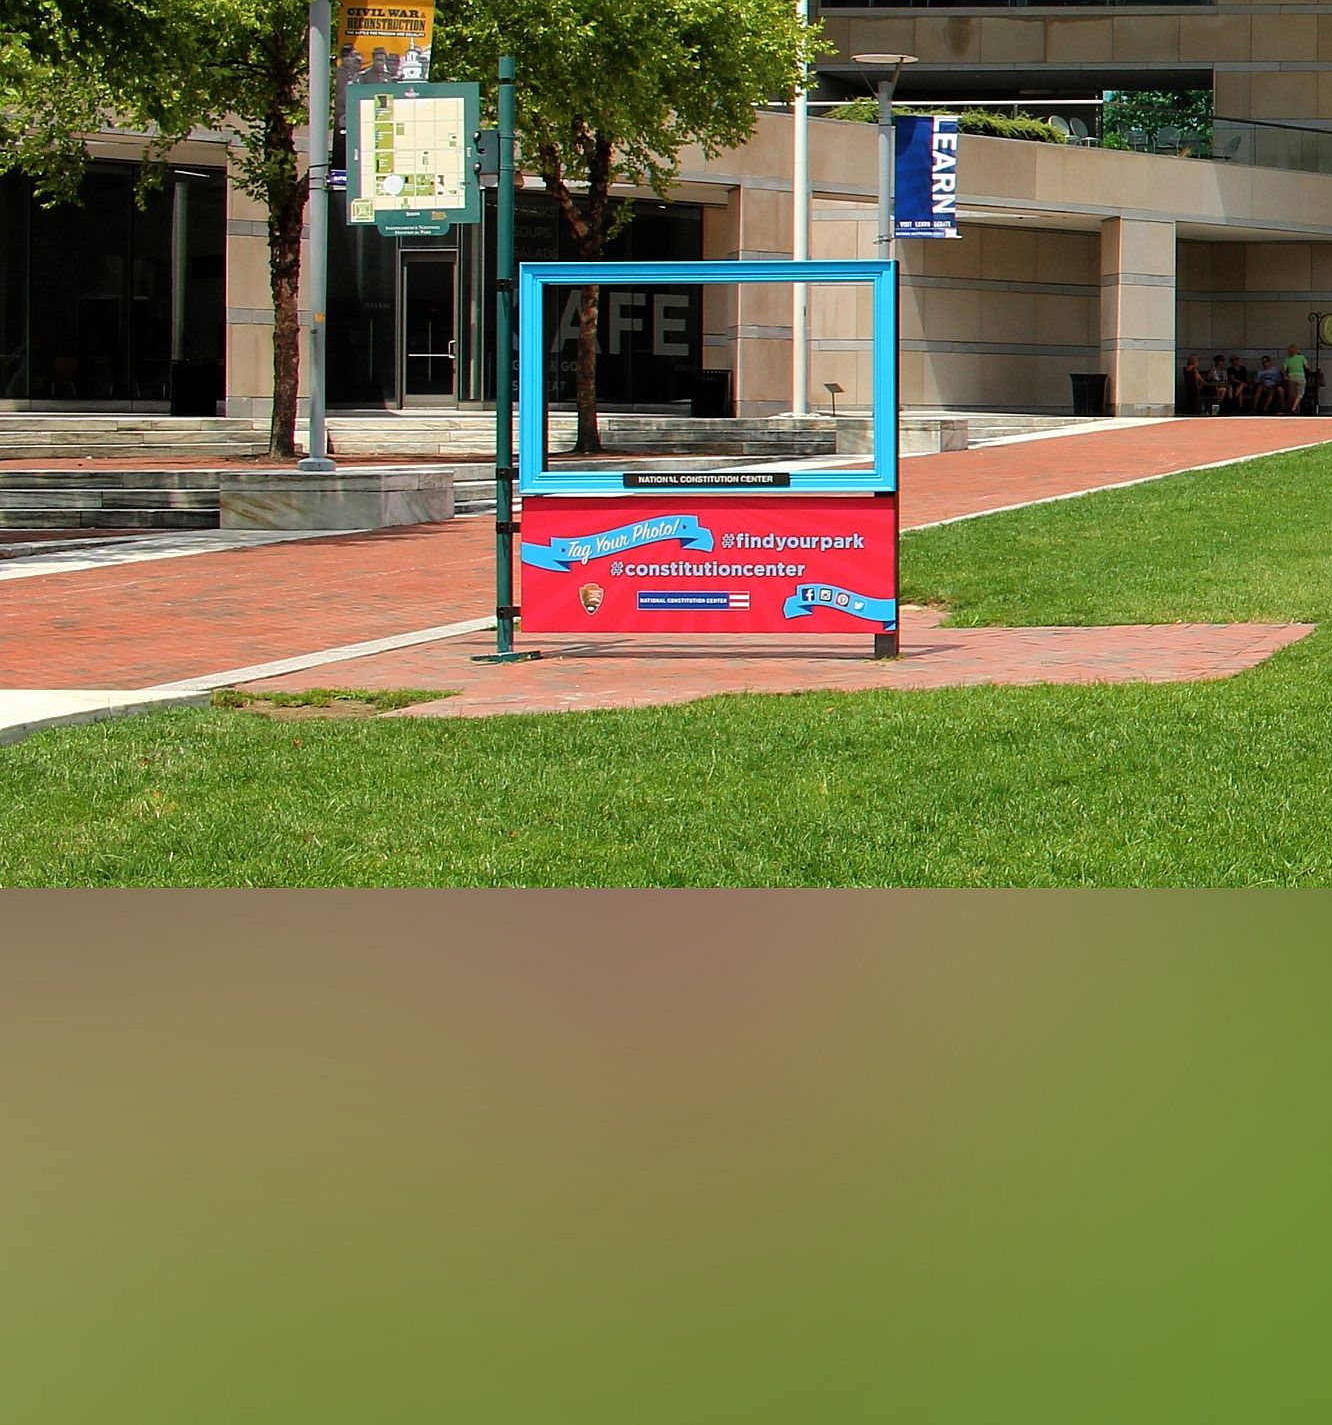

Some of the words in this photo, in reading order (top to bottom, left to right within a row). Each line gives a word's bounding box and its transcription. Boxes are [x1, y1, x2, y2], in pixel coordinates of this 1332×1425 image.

[347, 7, 385, 17] CIVIL
[387, 9, 419, 18] WAR
[347, 17, 426, 31] RECONSTRUCTION
[932, 115, 960, 213] LEARN
[638, 475, 678, 484] NATIONAL
[679, 475, 739, 483] CONSTITUTION
[740, 475, 774, 483] CENTER
[567, 541, 592, 565] Tag
[595, 537, 630, 554] Your
[632, 518, 681, 542] Photo!
[721, 533, 865, 553] #findyourpark
[610, 560, 806, 578] #constitutioncenter
